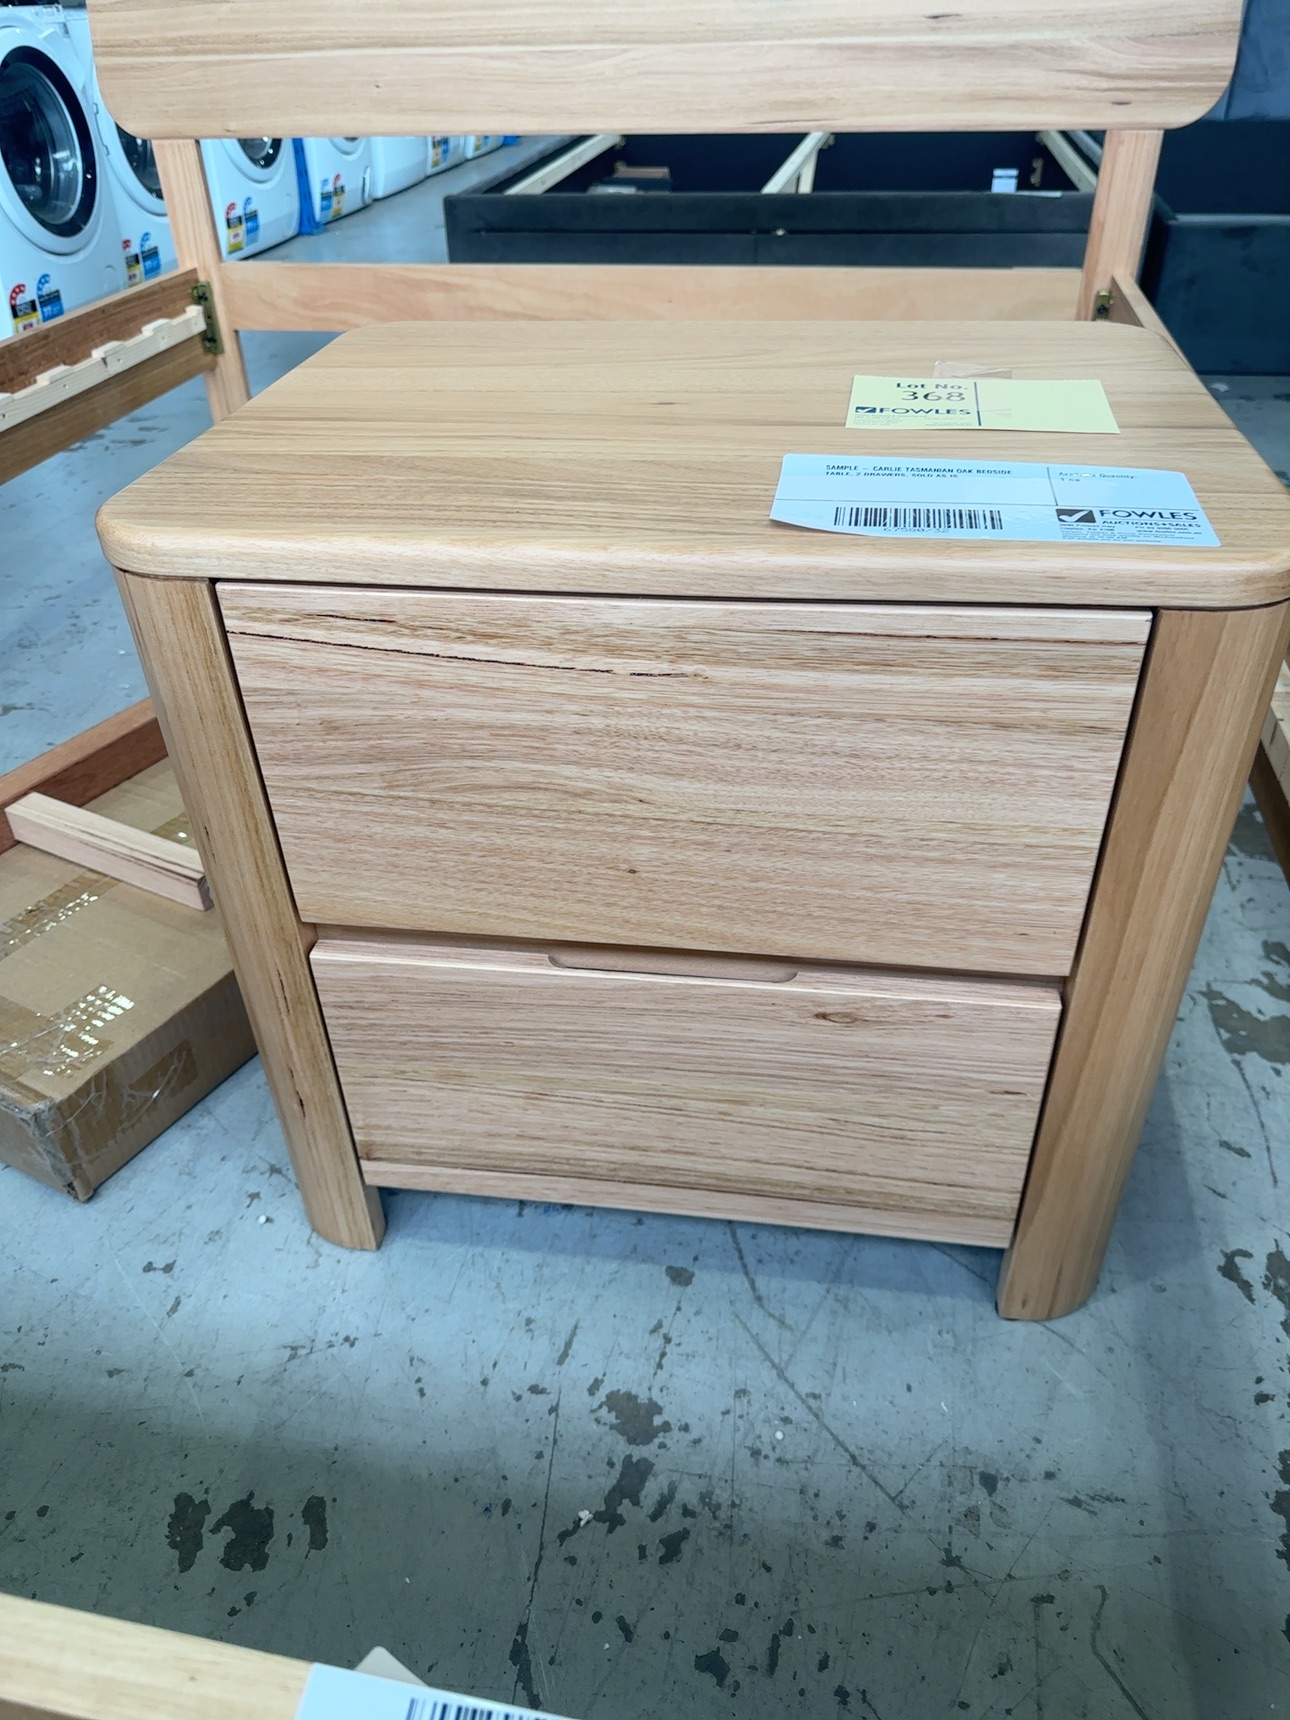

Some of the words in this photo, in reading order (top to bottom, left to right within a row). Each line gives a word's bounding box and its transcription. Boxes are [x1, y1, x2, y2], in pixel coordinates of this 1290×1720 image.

[901, 390, 966, 402] 368
[879, 406, 972, 415] FOWLES
[905, 466, 954, 474] TASMANIAN
[1099, 509, 1198, 521] FOWLES
